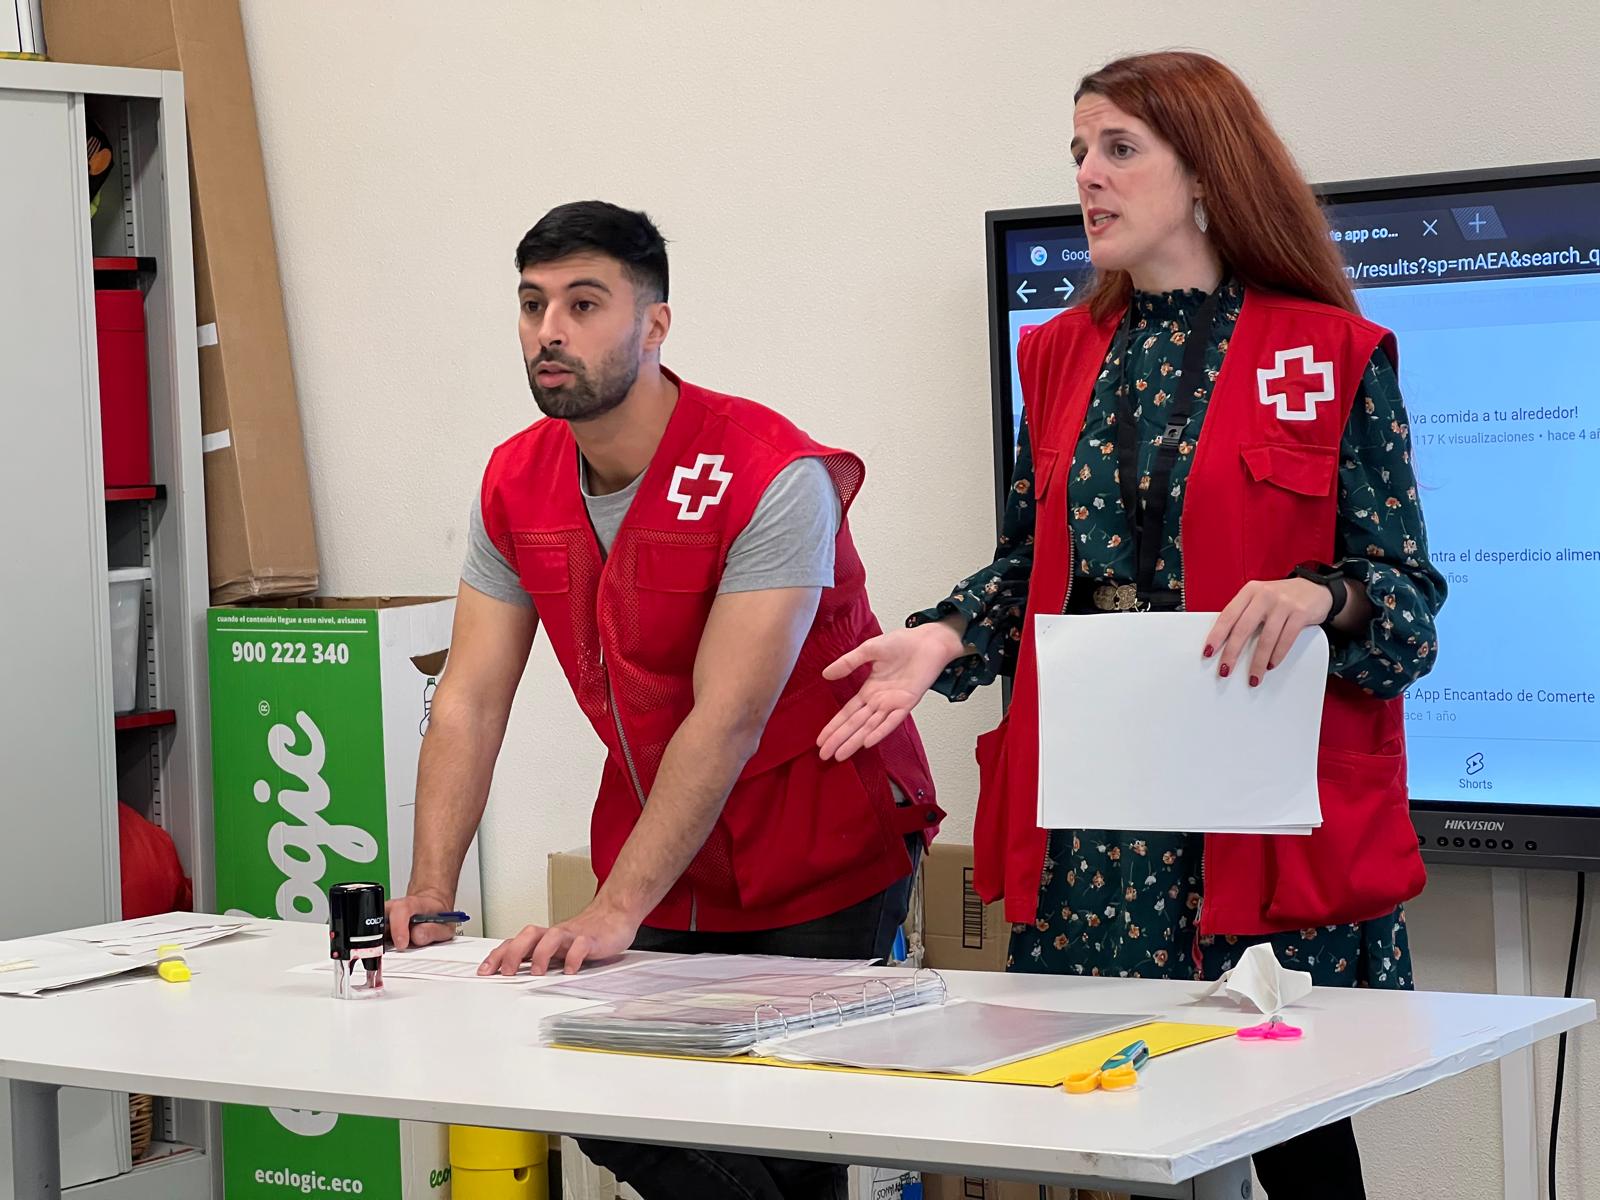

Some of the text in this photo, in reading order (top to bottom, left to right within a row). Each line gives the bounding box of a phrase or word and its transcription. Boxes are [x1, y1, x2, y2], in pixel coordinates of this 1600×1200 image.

[1345, 229, 1369, 243] app
[1372, 228, 1398, 239] co...
[1431, 408, 1479, 424] comida
[1483, 410, 1490, 422] a
[1495, 408, 1507, 421] tu
[1511, 405, 1578, 420] alrededor!
[1438, 433, 1446, 445] K
[1449, 430, 1535, 444] visualizaciones
[1547, 429, 1575, 441] hace
[1579, 429, 1586, 440] 4
[1460, 549, 1471, 562] el
[1475, 547, 1552, 565] desperdicio
[246, 616, 277, 624] contenido
[277, 616, 297, 625] llegue
[337, 616, 367, 624] avisanos
[232, 642, 349, 664] 900 222 340
[1414, 688, 1440, 704] App
[1444, 688, 1513, 702] Encantado
[1517, 689, 1533, 702] de
[1537, 689, 1595, 704] Comerte
[1436, 710, 1457, 722] año
[1459, 779, 1493, 790] Shorts
[1444, 819, 1505, 832] HIKVISION
[255, 1168, 363, 1194] ecologic.eco
[430, 1166, 451, 1188] eco
